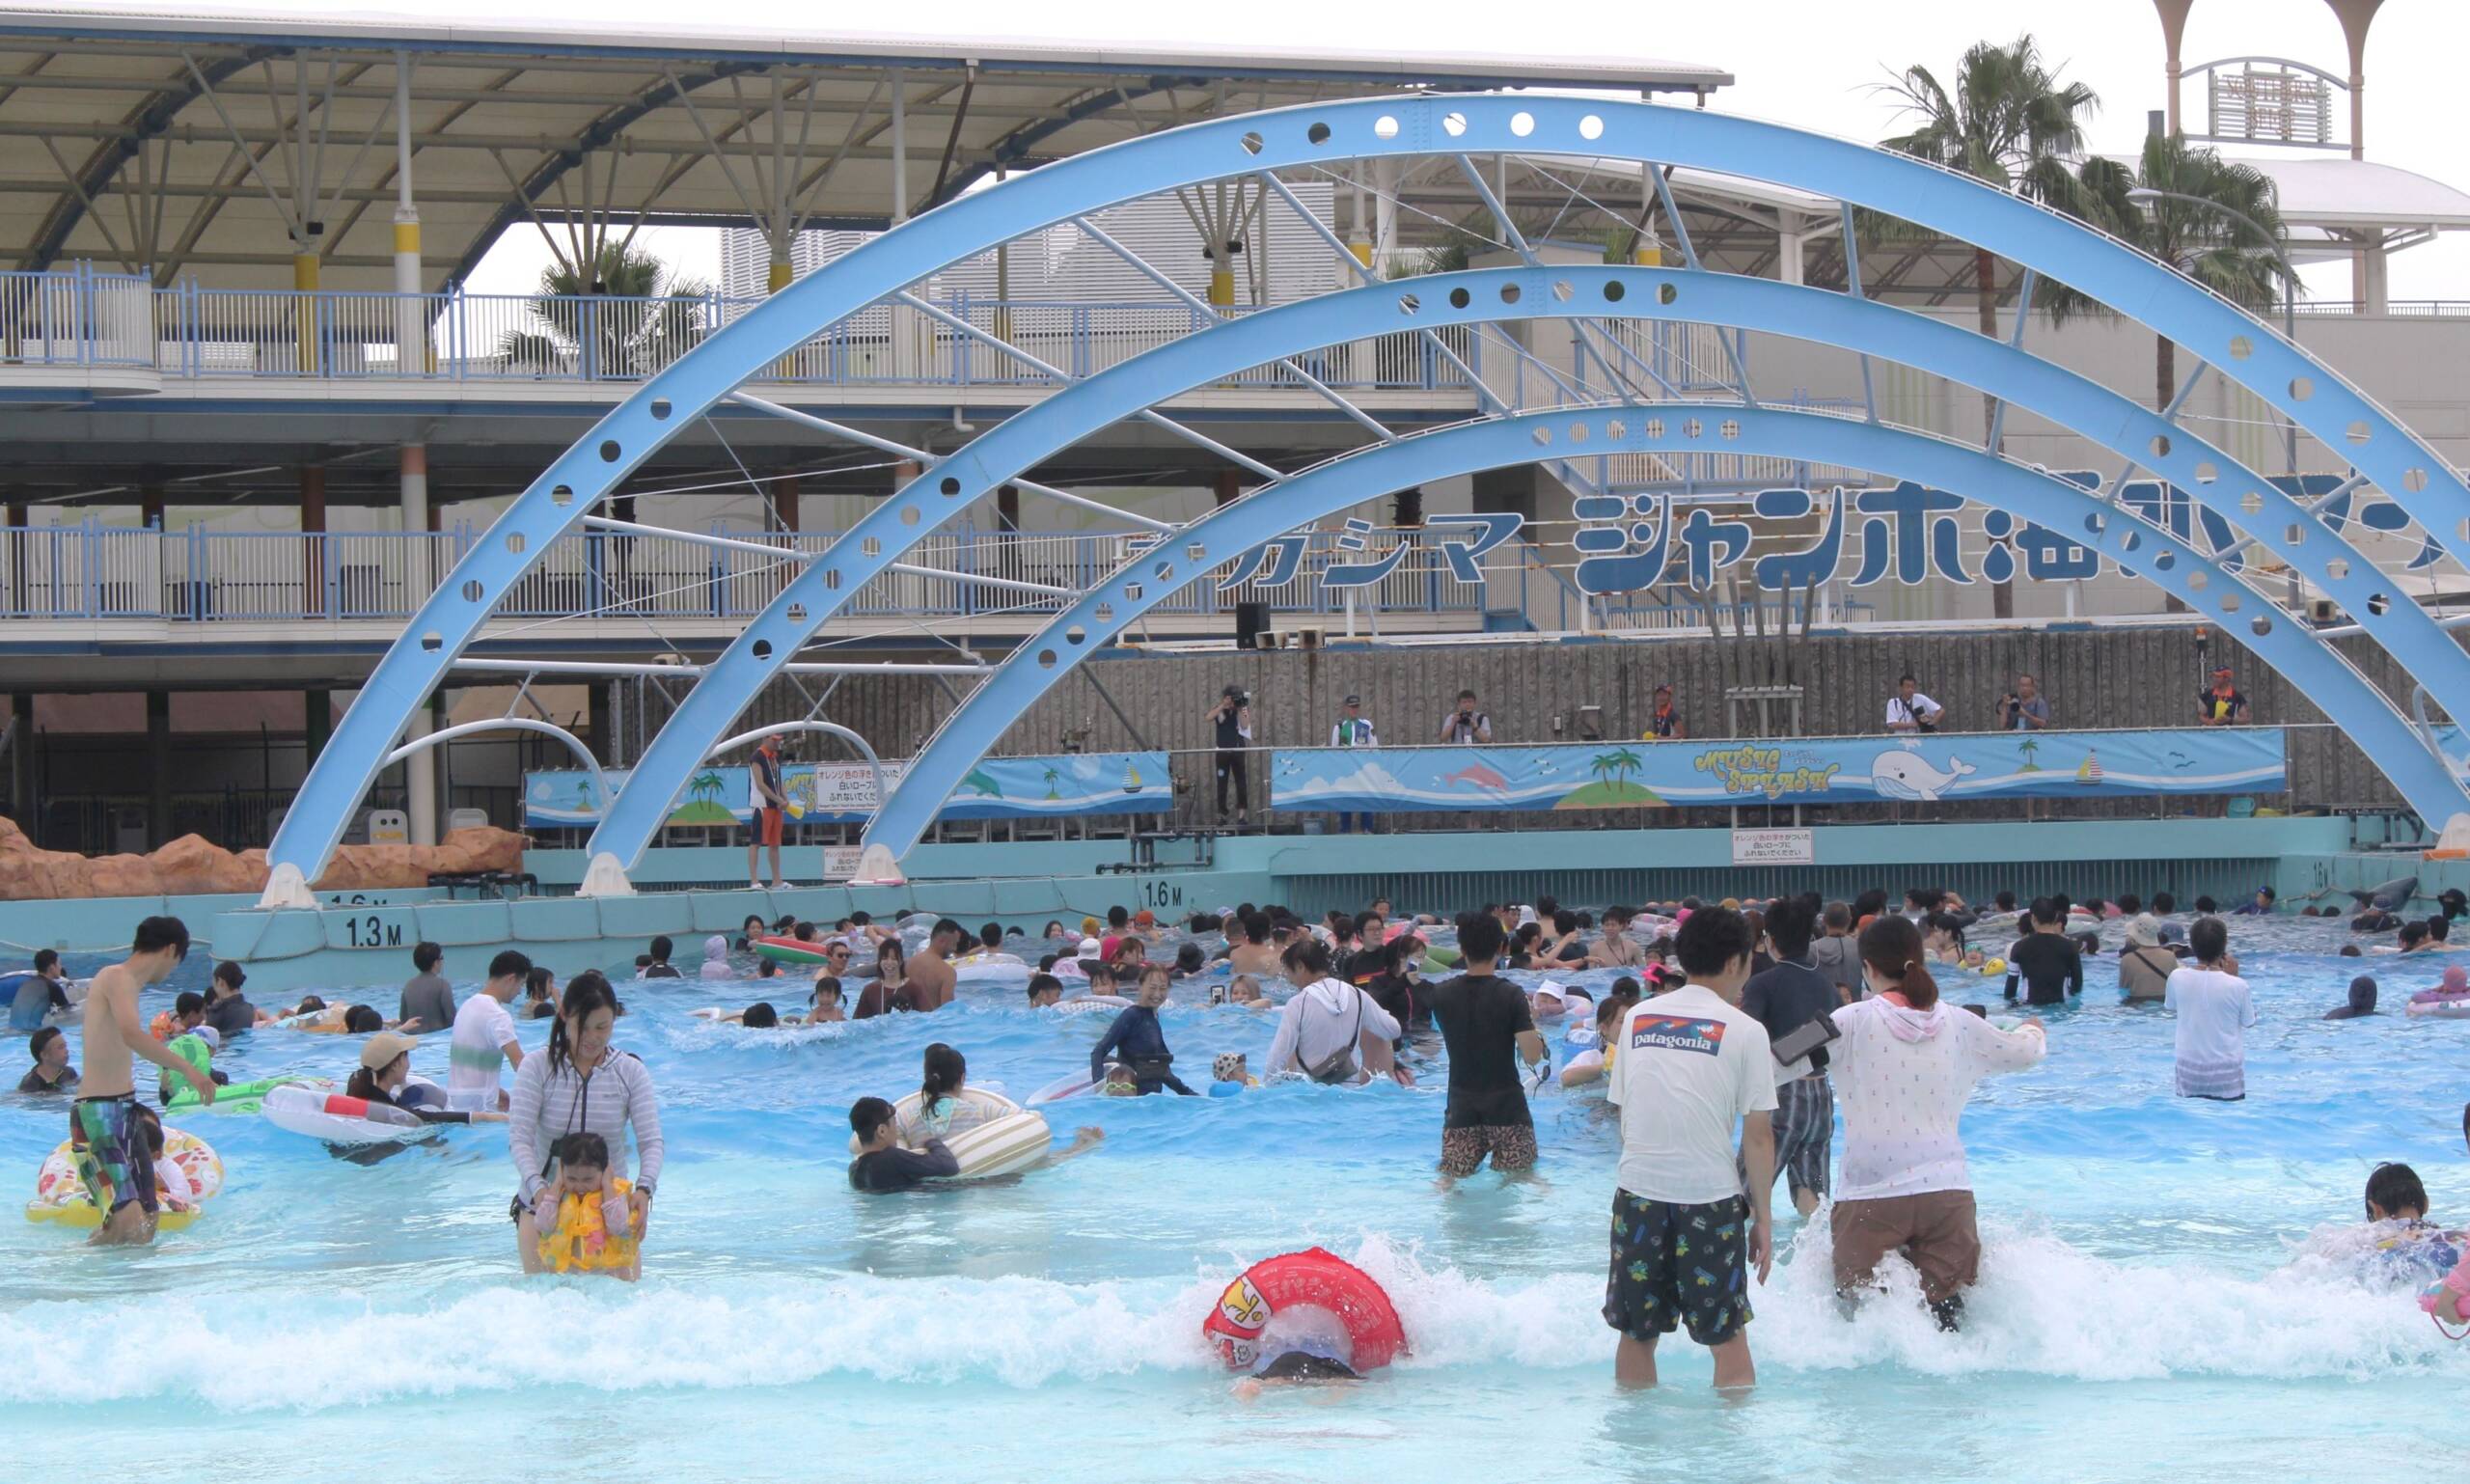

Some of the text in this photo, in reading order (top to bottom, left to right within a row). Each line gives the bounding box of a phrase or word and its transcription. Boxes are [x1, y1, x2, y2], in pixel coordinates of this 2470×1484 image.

[1127, 512, 1524, 591] ガシマ
[818, 770, 899, 779] オレンジ色の浮きついた
[1694, 745, 1781, 780] MUSIC
[1725, 763, 1840, 800] SPLASH
[830, 793, 876, 802] ふれないでくだ
[1634, 1032, 1712, 1050] patagonia
